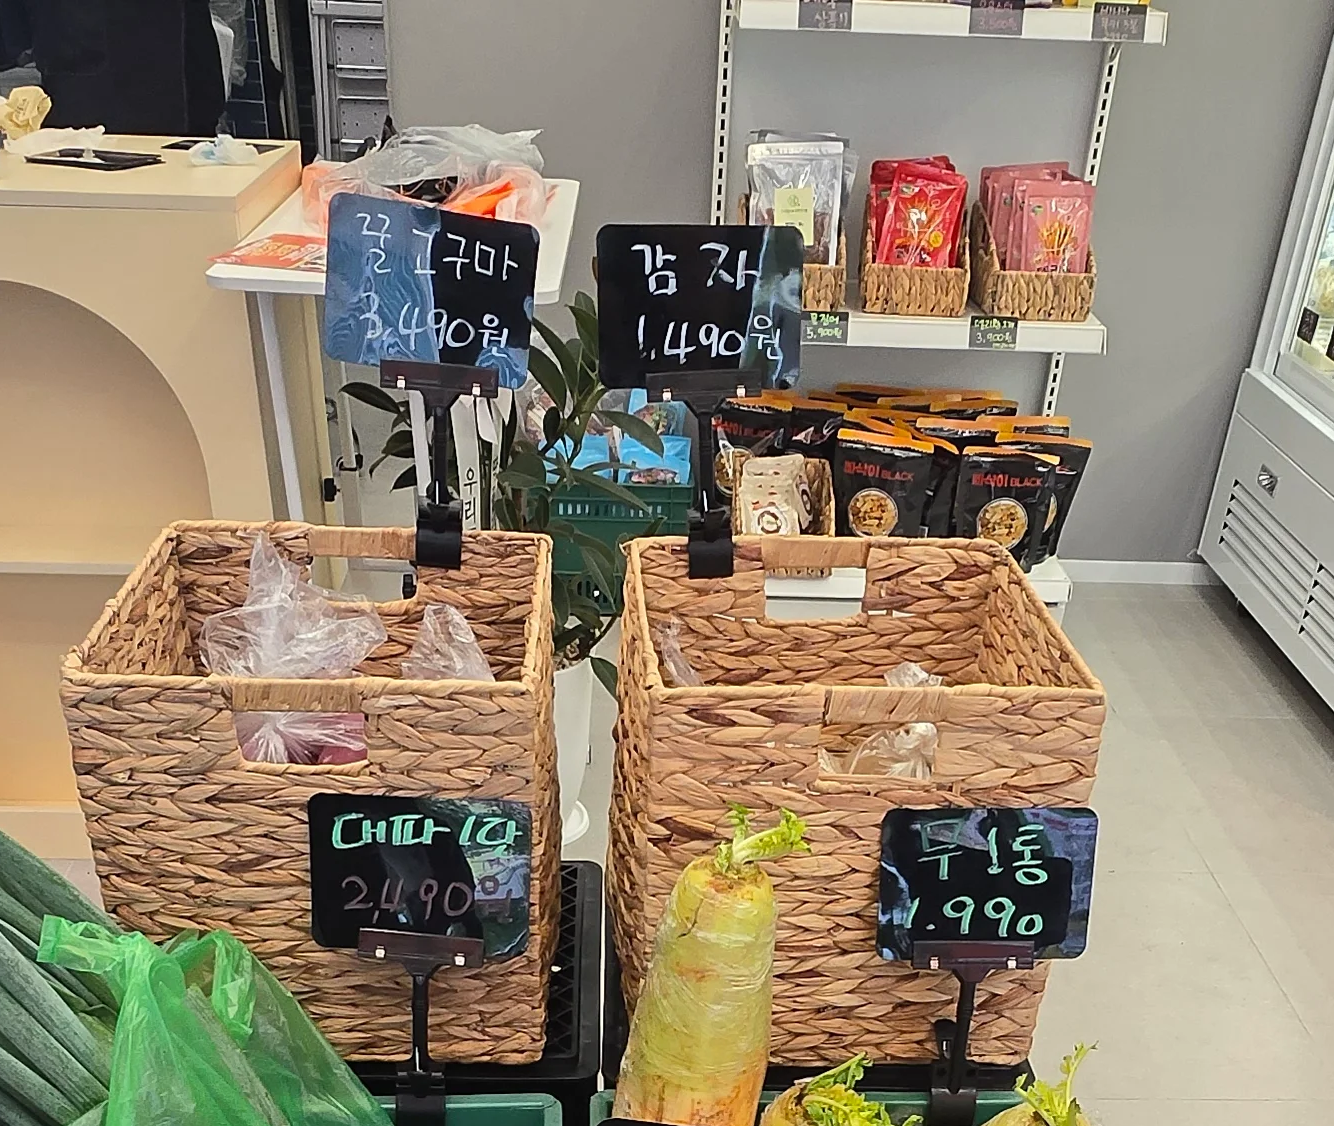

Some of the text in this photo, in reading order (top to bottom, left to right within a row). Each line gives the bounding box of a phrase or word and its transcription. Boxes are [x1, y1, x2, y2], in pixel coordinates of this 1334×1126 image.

[355, 212, 392, 275] 꿀
[412, 227, 519, 281] 고구마
[881, 469, 916, 482] BLACK
[1010, 477, 1044, 488] BLACK
[463, 466, 478, 531] 우리
[331, 812, 451, 850] 대파
